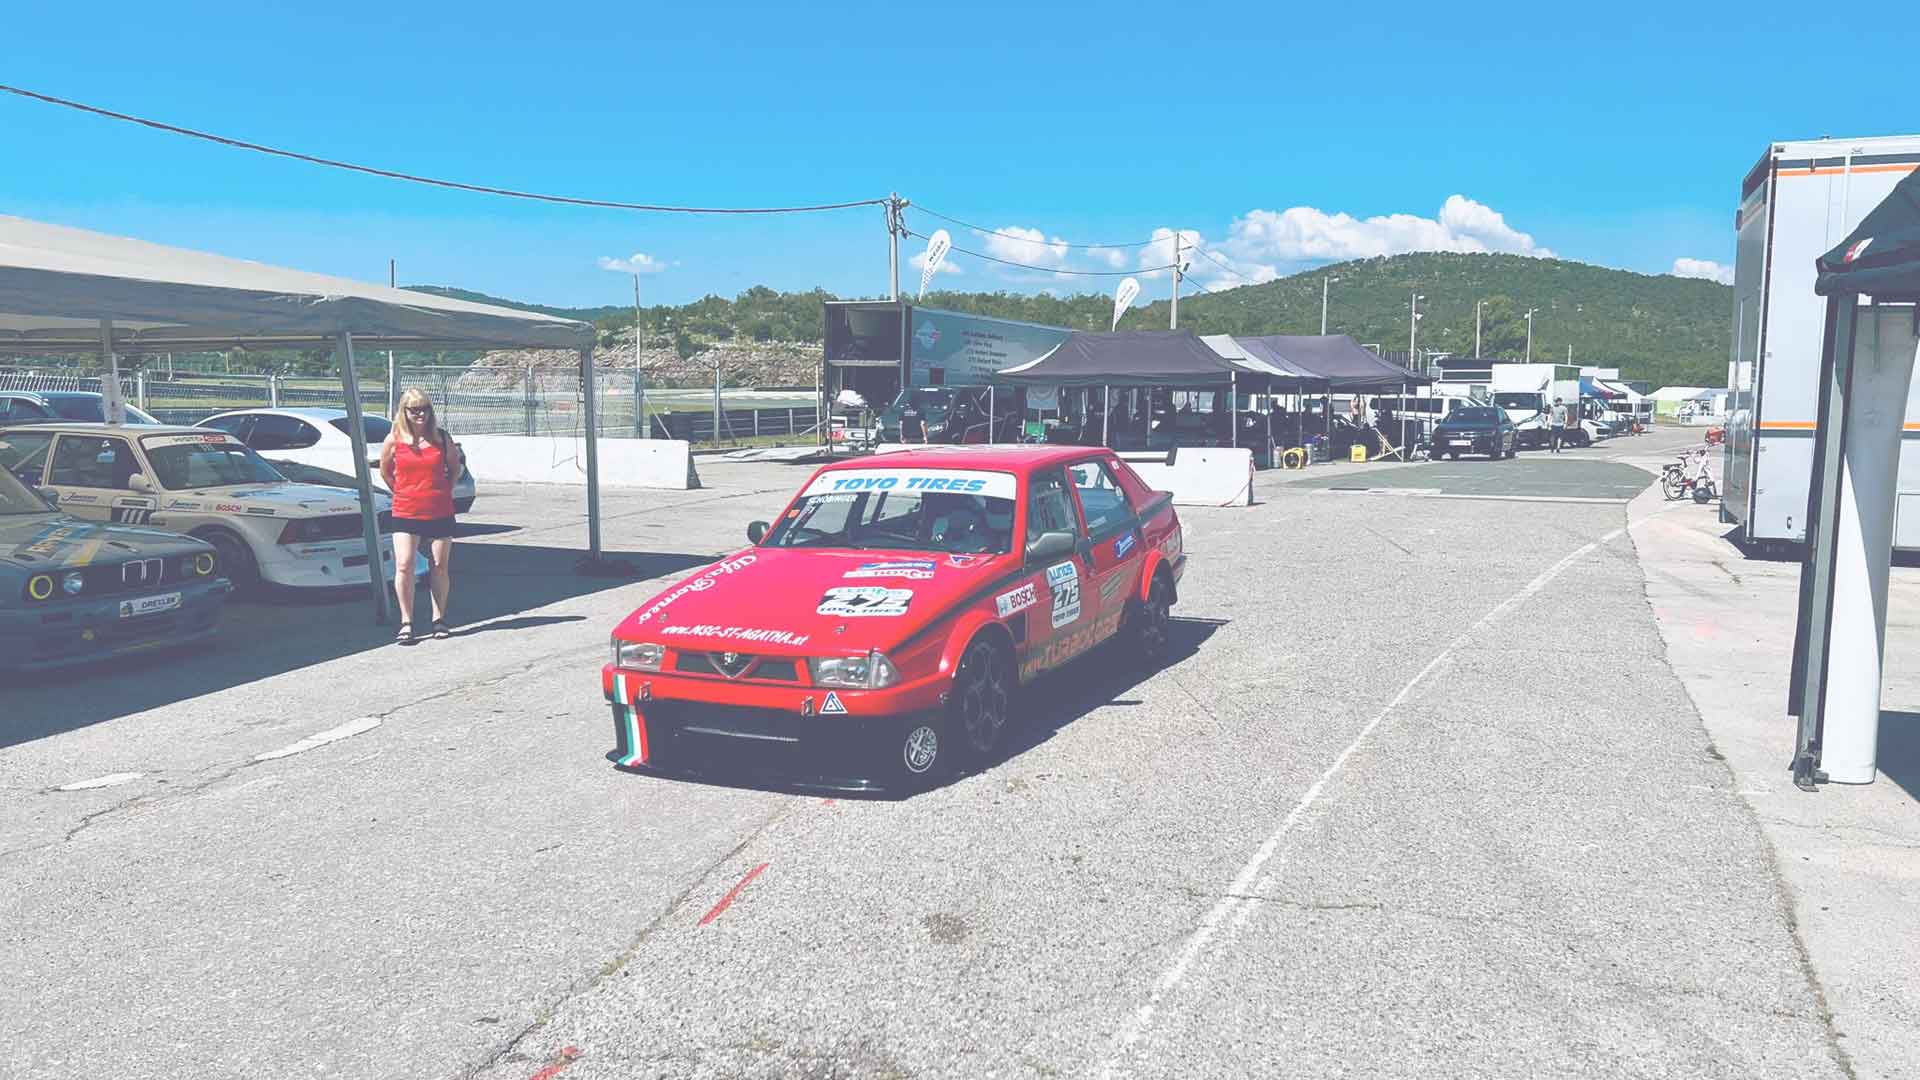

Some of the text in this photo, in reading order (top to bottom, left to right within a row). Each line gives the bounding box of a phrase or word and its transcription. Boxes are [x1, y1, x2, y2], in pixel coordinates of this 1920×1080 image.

[832, 477, 987, 491] TOYO TIRES
[704, 554, 757, 578] Alfa
[1009, 586, 1035, 609] BOSCH
[1053, 579, 1079, 611] 275
